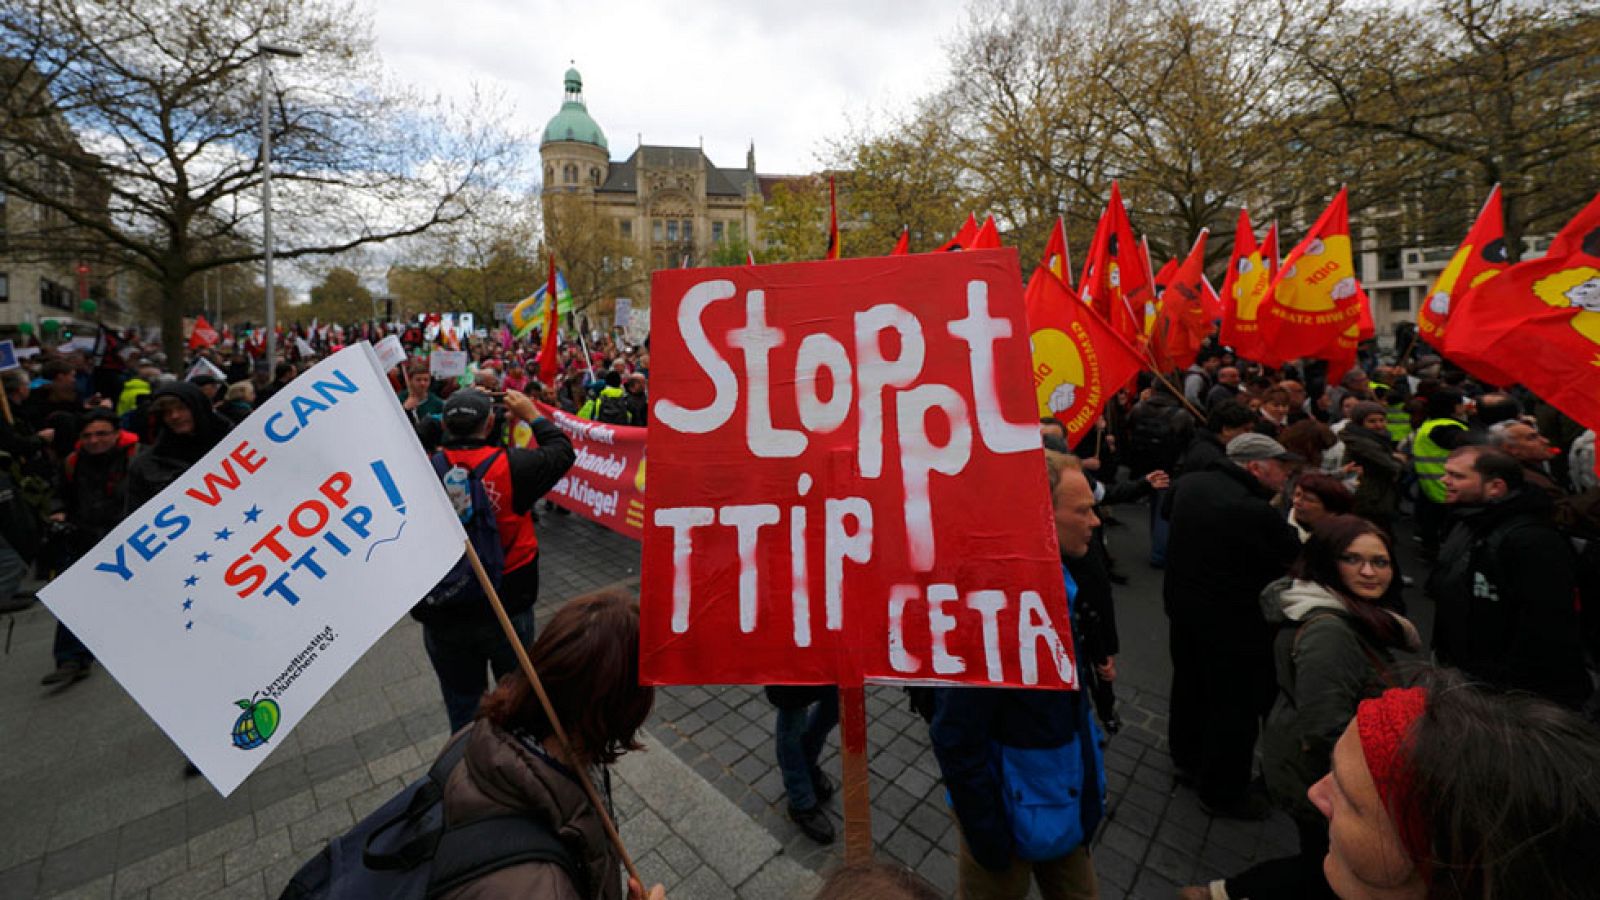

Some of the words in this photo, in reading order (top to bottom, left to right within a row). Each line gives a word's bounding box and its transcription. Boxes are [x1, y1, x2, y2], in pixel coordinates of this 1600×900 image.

[95, 504, 191, 581] YES
[185, 441, 268, 507] WE
[264, 369, 359, 444] CAN
[653, 279, 1042, 572] Stoppt
[224, 471, 353, 599] STOP
[569, 476, 619, 517] Kriege!
[261, 625, 334, 696] Umweltinstitut
[319, 632, 339, 651] e.V.
[887, 583, 1076, 686] CETA
